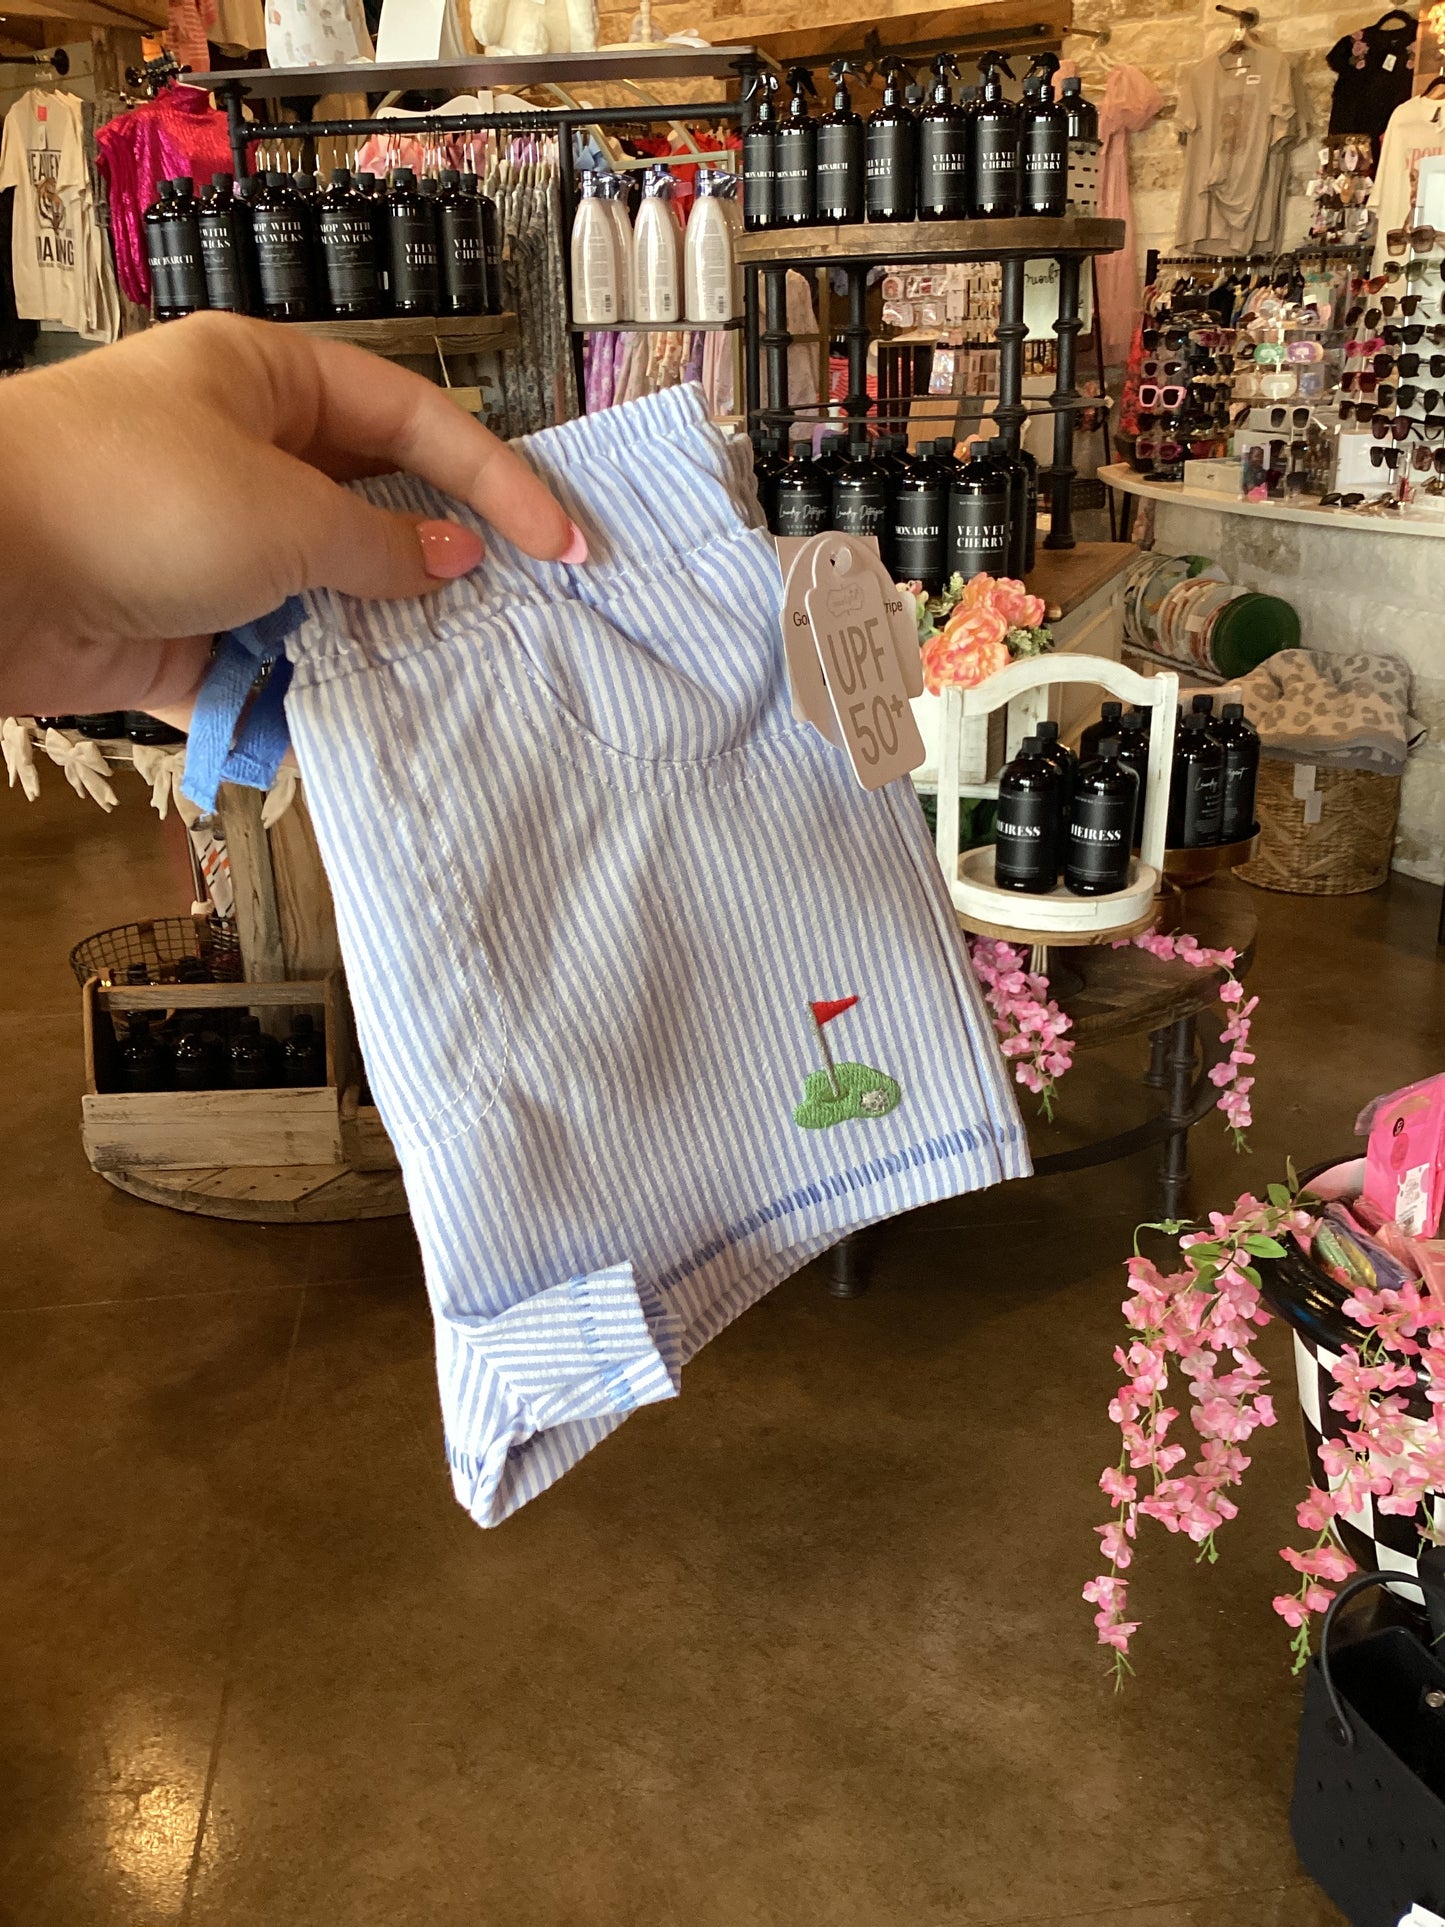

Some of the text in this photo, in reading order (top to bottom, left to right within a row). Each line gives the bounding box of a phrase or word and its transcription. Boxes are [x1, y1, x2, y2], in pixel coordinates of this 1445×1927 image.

[1026, 152, 1061, 162] VELVET
[1025, 161, 1061, 171] CHERRY
[894, 525, 940, 536] MONARCH
[957, 524, 1005, 536] VELVET
[956, 536, 1005, 548] CHERRY
[827, 616, 885, 696] UPF
[848, 694, 904, 766] 50+
[1070, 823, 1122, 841] HEIRESS
